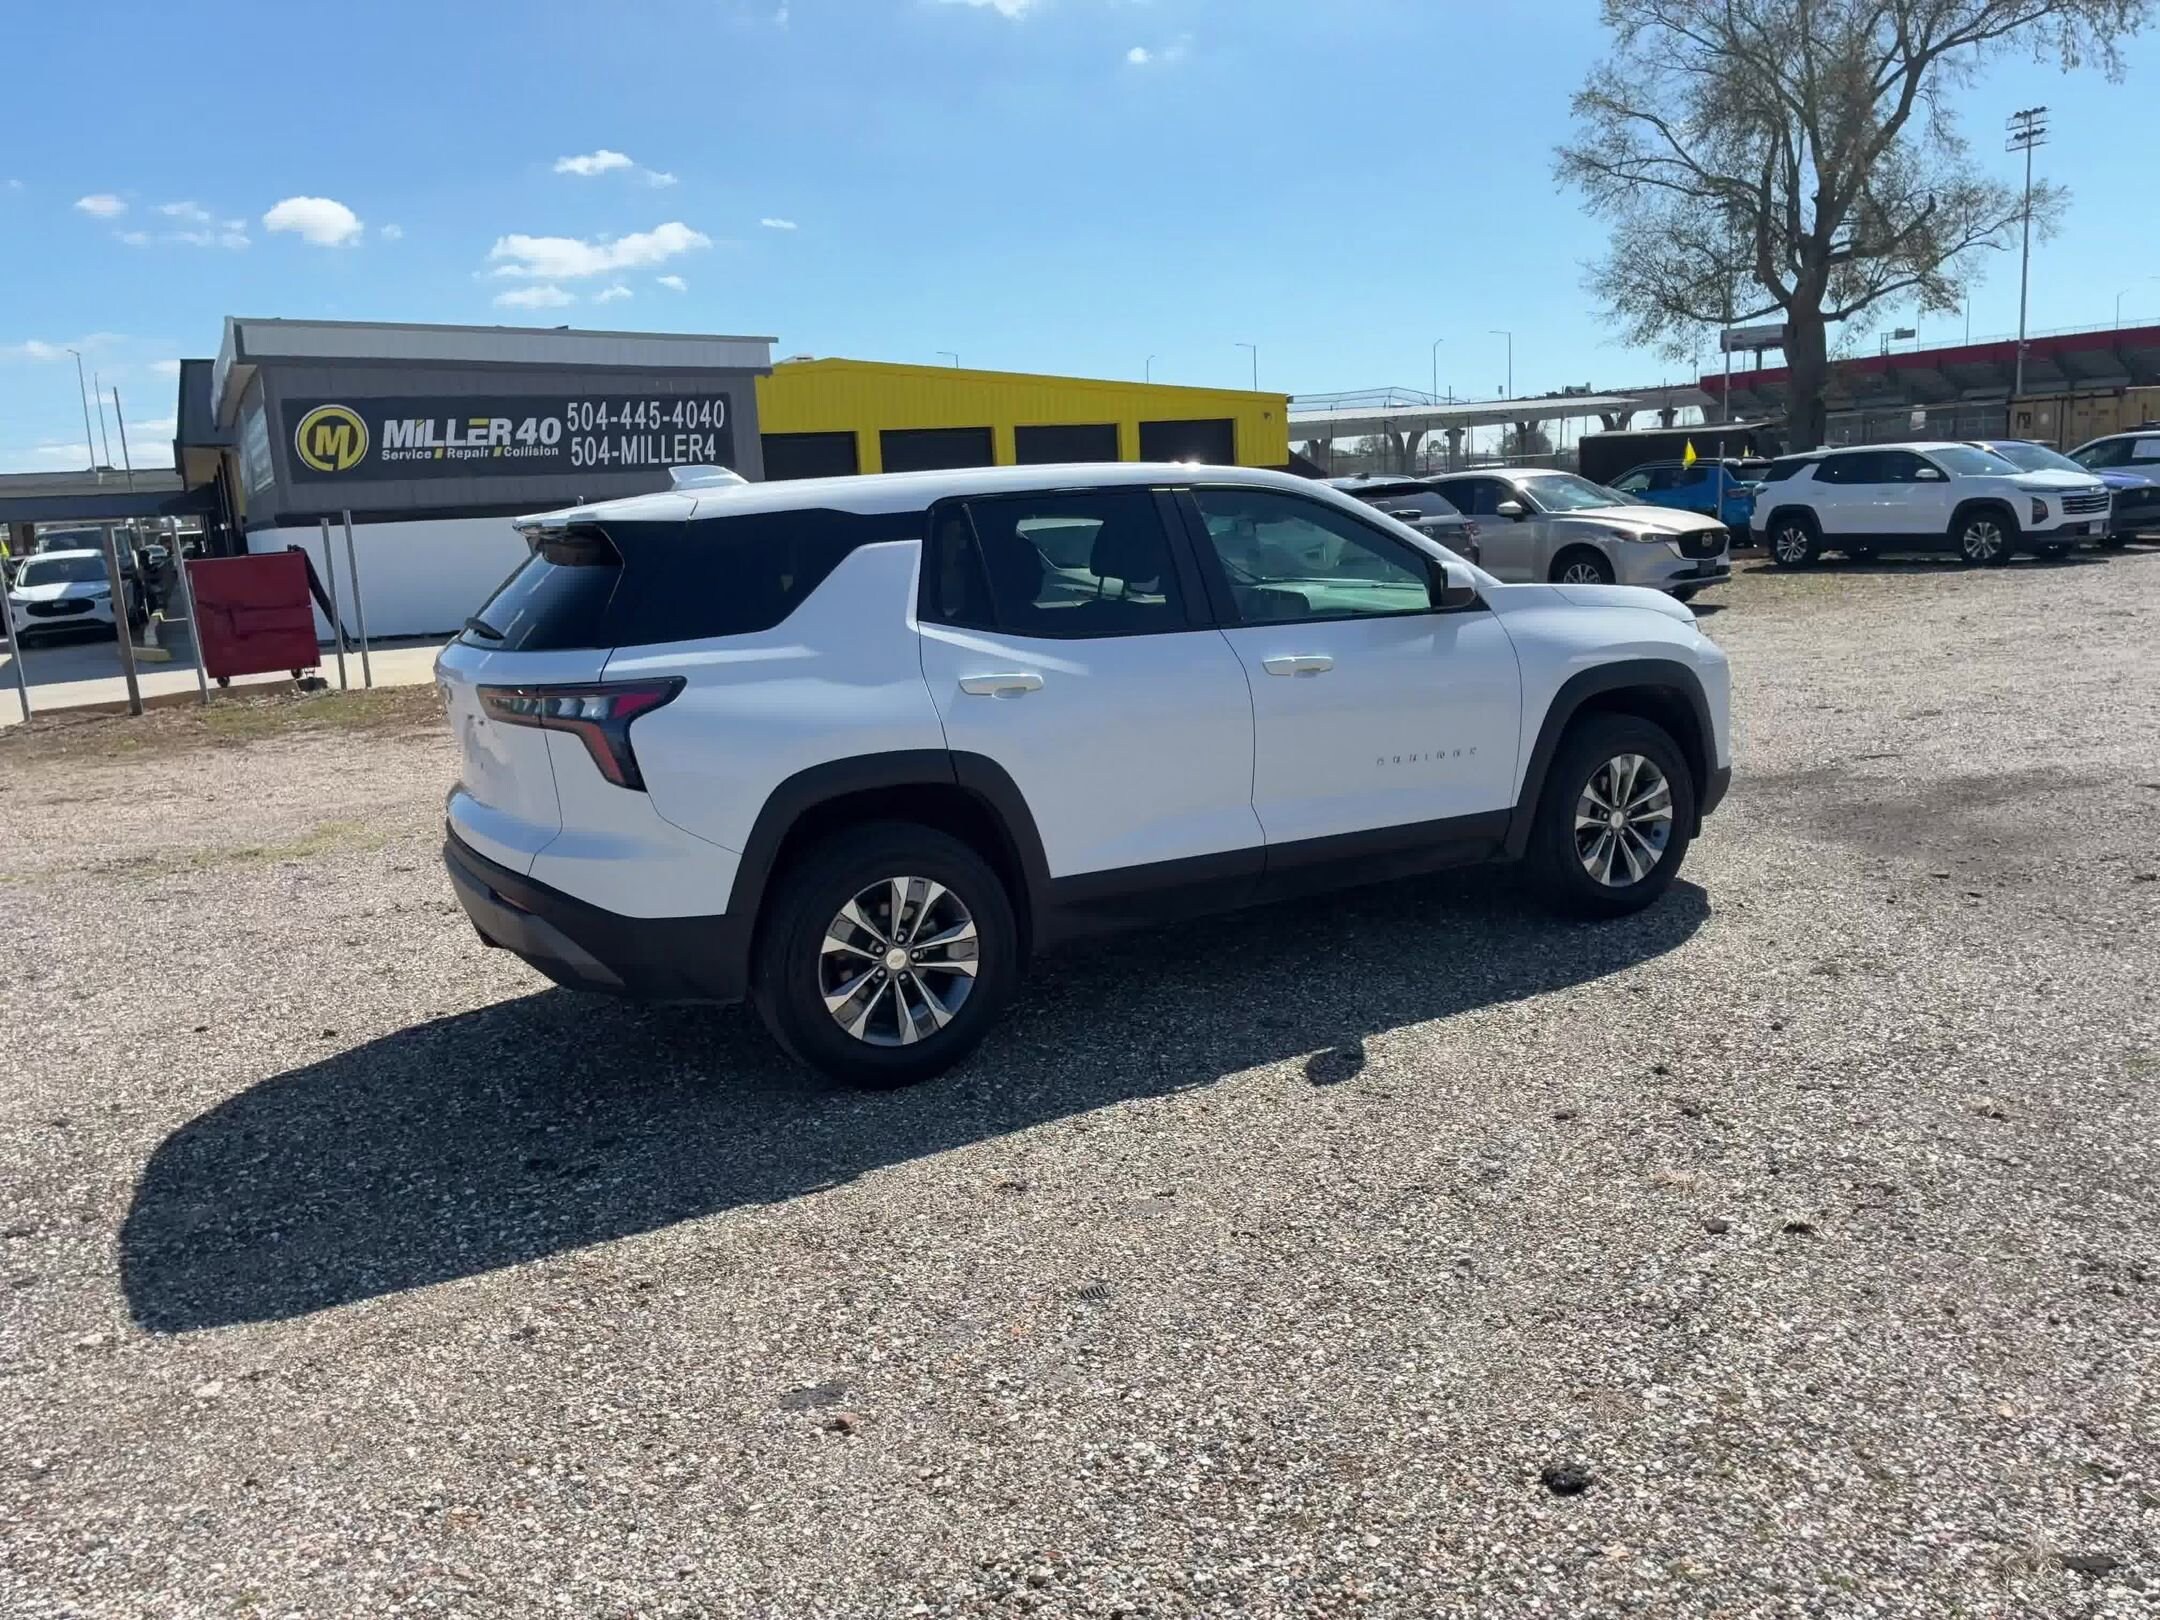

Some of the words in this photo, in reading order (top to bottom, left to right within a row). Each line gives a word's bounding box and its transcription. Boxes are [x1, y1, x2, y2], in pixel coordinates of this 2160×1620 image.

[567, 400, 725, 431] 504-445-4040
[381, 449, 432, 461] Service
[447, 447, 489, 460] Repair
[504, 446, 559, 457] Collision
[571, 433, 716, 466] 504-MILLER4
